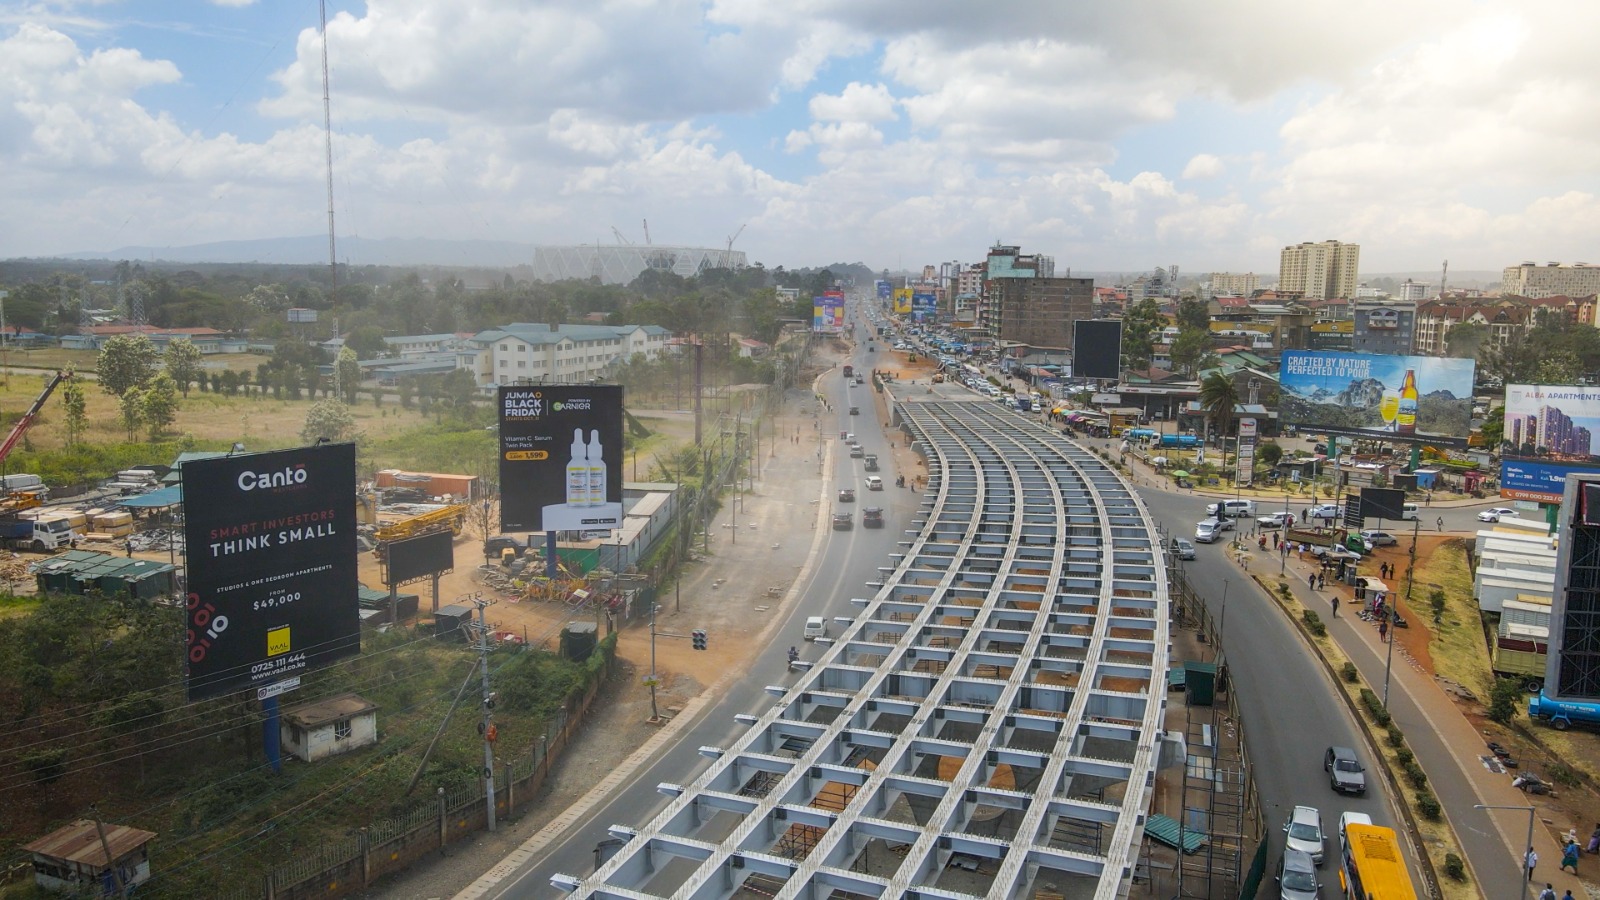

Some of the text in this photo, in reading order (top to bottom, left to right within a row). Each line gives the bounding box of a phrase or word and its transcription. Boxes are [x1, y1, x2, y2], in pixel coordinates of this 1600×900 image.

[1288, 356, 1323, 367] CRAFTED
[1326, 357, 1337, 367] BY
[1287, 365, 1332, 376] PERFECTED
[1335, 367, 1345, 377] TO
[505, 391, 535, 399] JUMIA
[505, 399, 541, 408] BLACK
[554, 402, 591, 411] GARNIER
[505, 408, 541, 416] FRIDAY
[211, 510, 335, 540] SMART INVESTORS
[210, 523, 336, 557] THINK SMALL
[216, 582, 244, 593] STUDIOS
[265, 572, 294, 582] BEDROOM
[295, 564, 332, 576] APARTMENTS
[269, 589, 286, 597] FROM
[253, 592, 301, 611] $49,000
[270, 642, 288, 651] VAAL
[251, 661, 273, 673] 0725
[275, 657, 286, 667] 111
[251, 661, 306, 680] www.vaal.co.ke
